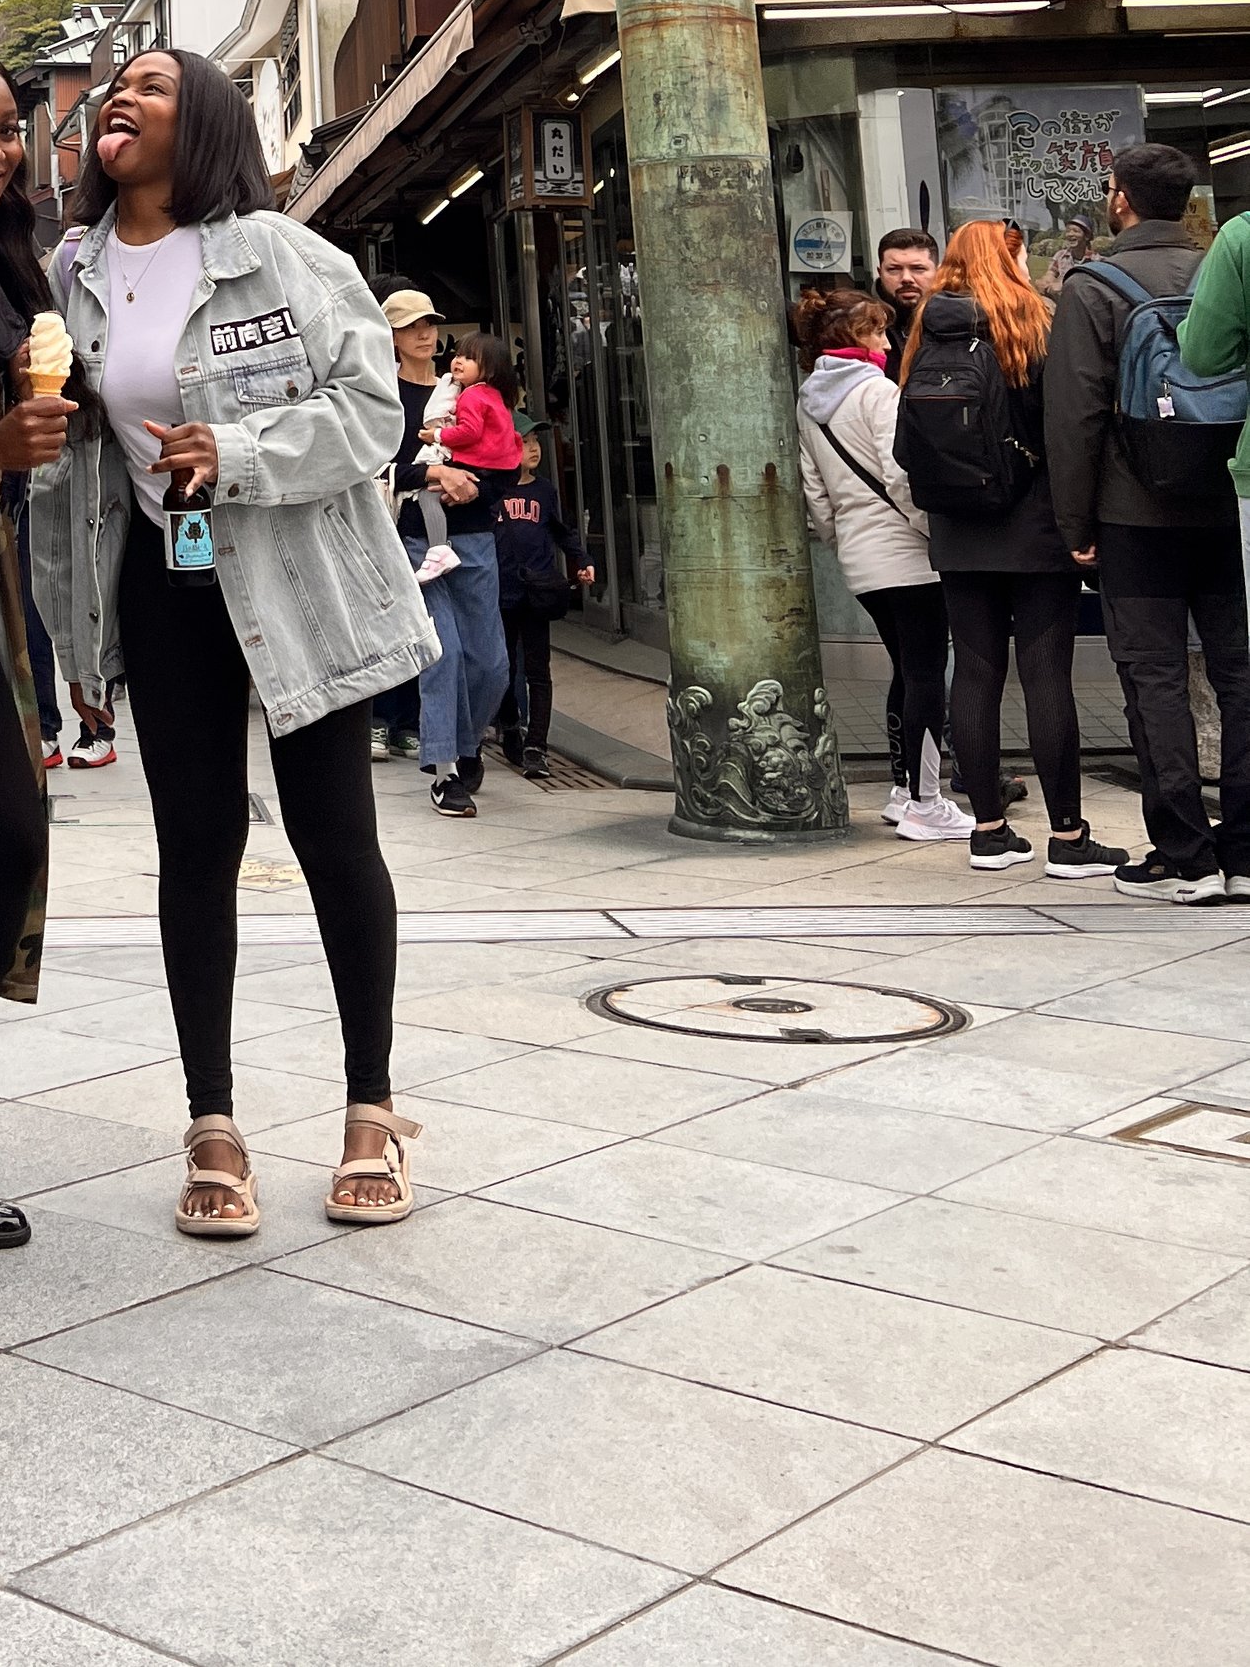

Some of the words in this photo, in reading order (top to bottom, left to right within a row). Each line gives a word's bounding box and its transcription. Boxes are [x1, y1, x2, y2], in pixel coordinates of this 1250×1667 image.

[1007, 110, 1121, 148] この街が
[551, 127, 565, 175] 丸だい
[1026, 176, 1110, 203] してくれ
